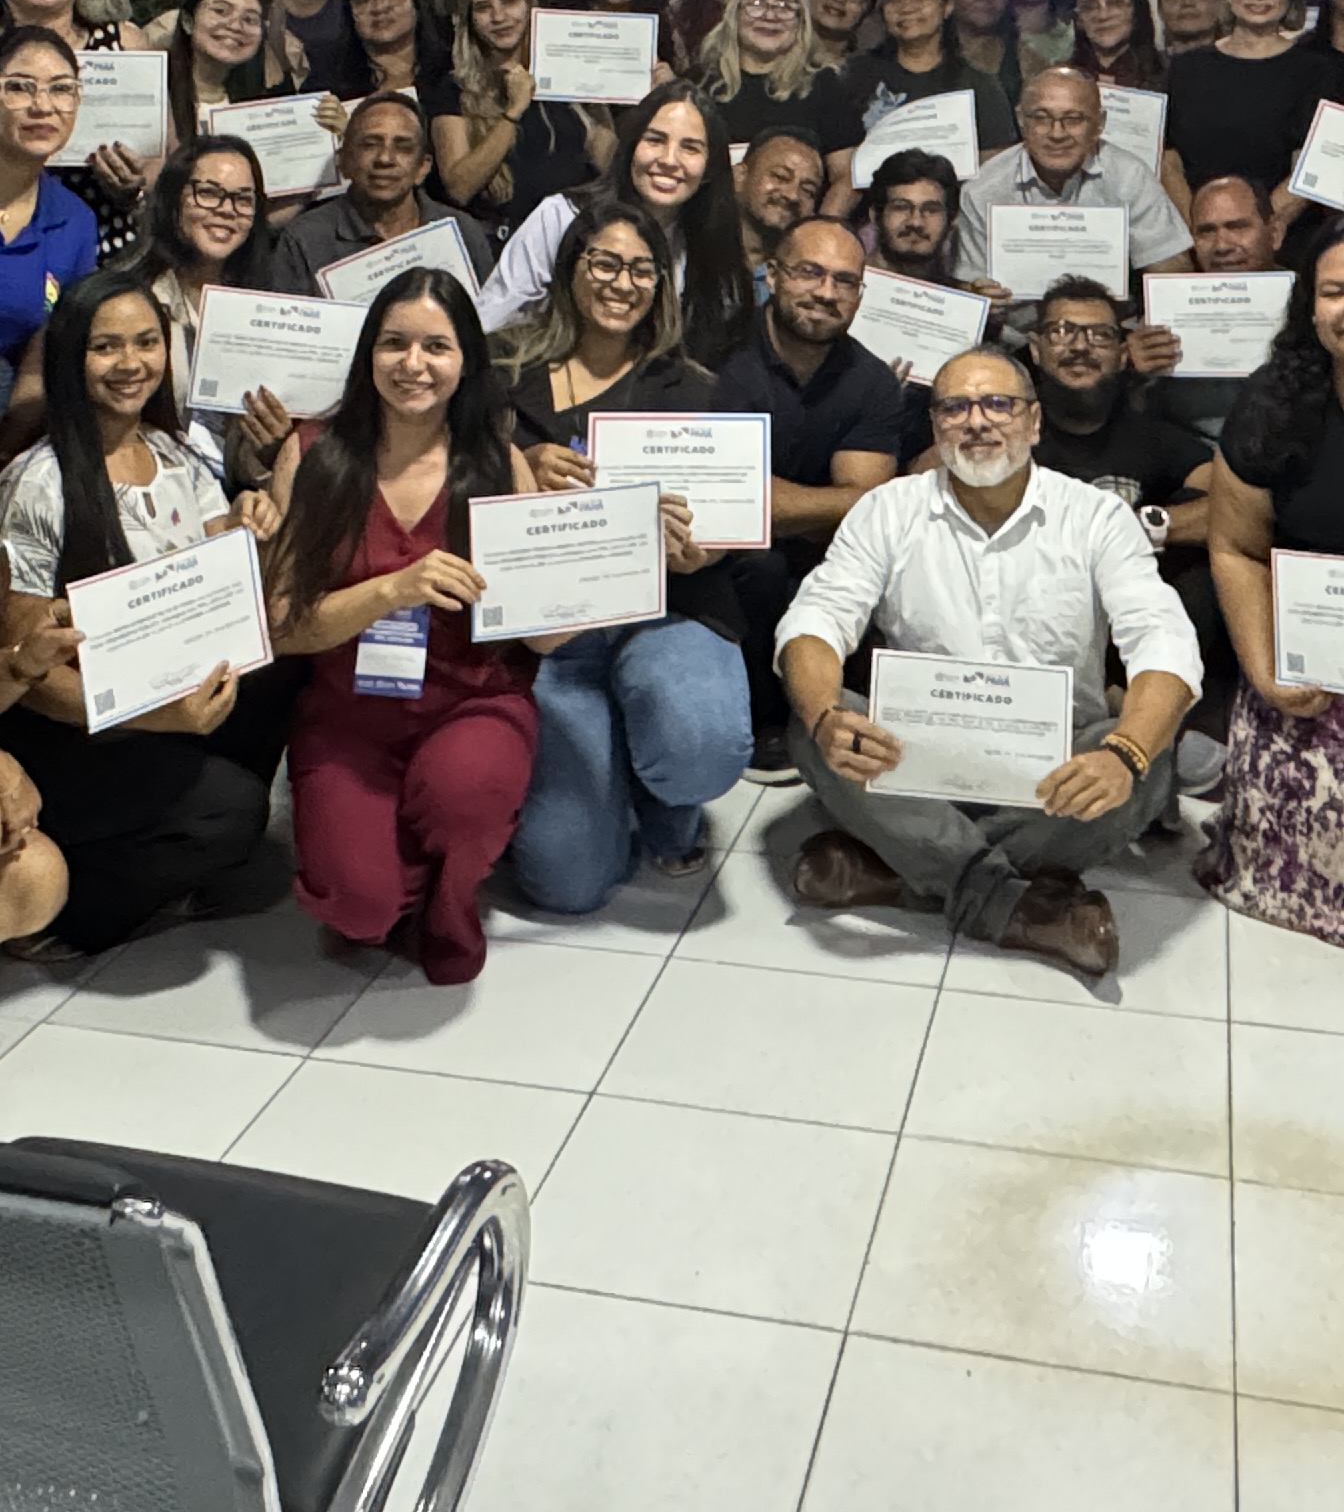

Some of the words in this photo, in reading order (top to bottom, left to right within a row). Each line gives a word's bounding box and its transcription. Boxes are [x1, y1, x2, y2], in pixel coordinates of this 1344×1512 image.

[250, 319, 322, 334] CERTIFICADO
[643, 445, 716, 455] CERTIFICADO
[526, 518, 608, 536] CERTIFICADO
[127, 574, 204, 610] CERTIFICADO
[930, 689, 1013, 705] CERTIFICADO
